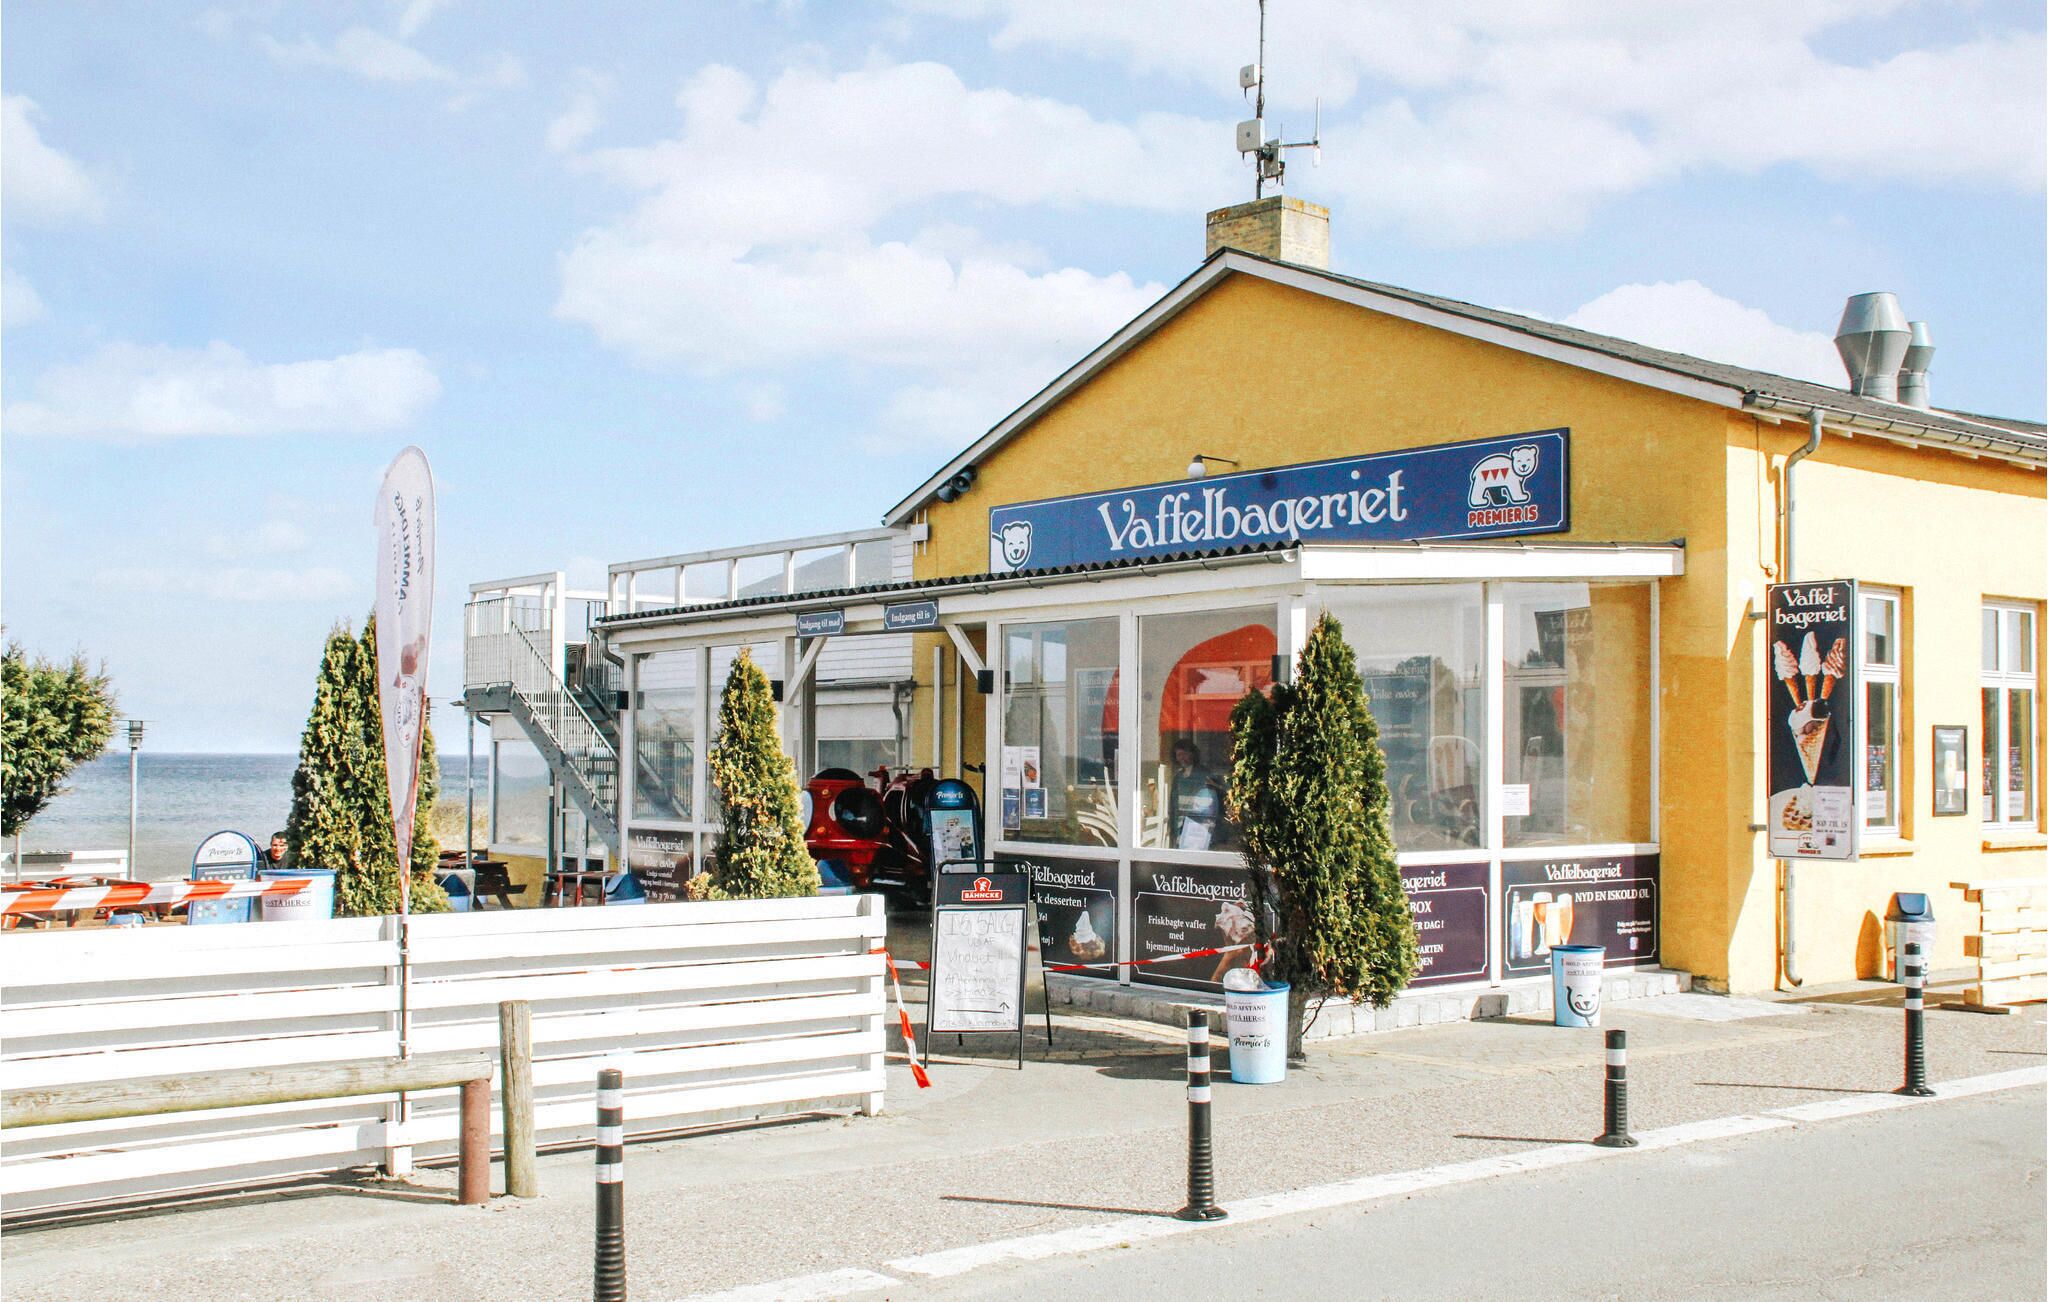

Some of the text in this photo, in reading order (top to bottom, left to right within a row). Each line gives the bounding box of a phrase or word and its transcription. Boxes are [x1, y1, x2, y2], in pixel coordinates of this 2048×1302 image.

[1097, 469, 1408, 551] Vaffelbageriet
[1468, 505, 1538, 528] PREMIER IS
[1782, 587, 1839, 606] Vaffel-
[799, 621, 821, 631] Indgang
[828, 617, 841, 627] mad
[892, 611, 931, 624] Indgang til is
[1775, 605, 1847, 629] bageriet
[1544, 862, 1622, 884] Vaffelbageriet
[1151, 873, 1248, 902] Vaffelbageriet
[1401, 870, 1447, 894] ageriet
[1044, 893, 1082, 908] desserten
[1575, 888, 1650, 903] NYD EN ISKOLD ØL
[1409, 900, 1432, 913] BOX
[1148, 915, 1207, 930] Friskbagte vafler
[1169, 931, 1184, 941] med
[1146, 940, 1191, 953] hjemmelavet
[1415, 943, 1444, 954] ARTEN
[1234, 1037, 1262, 1048] Premier
